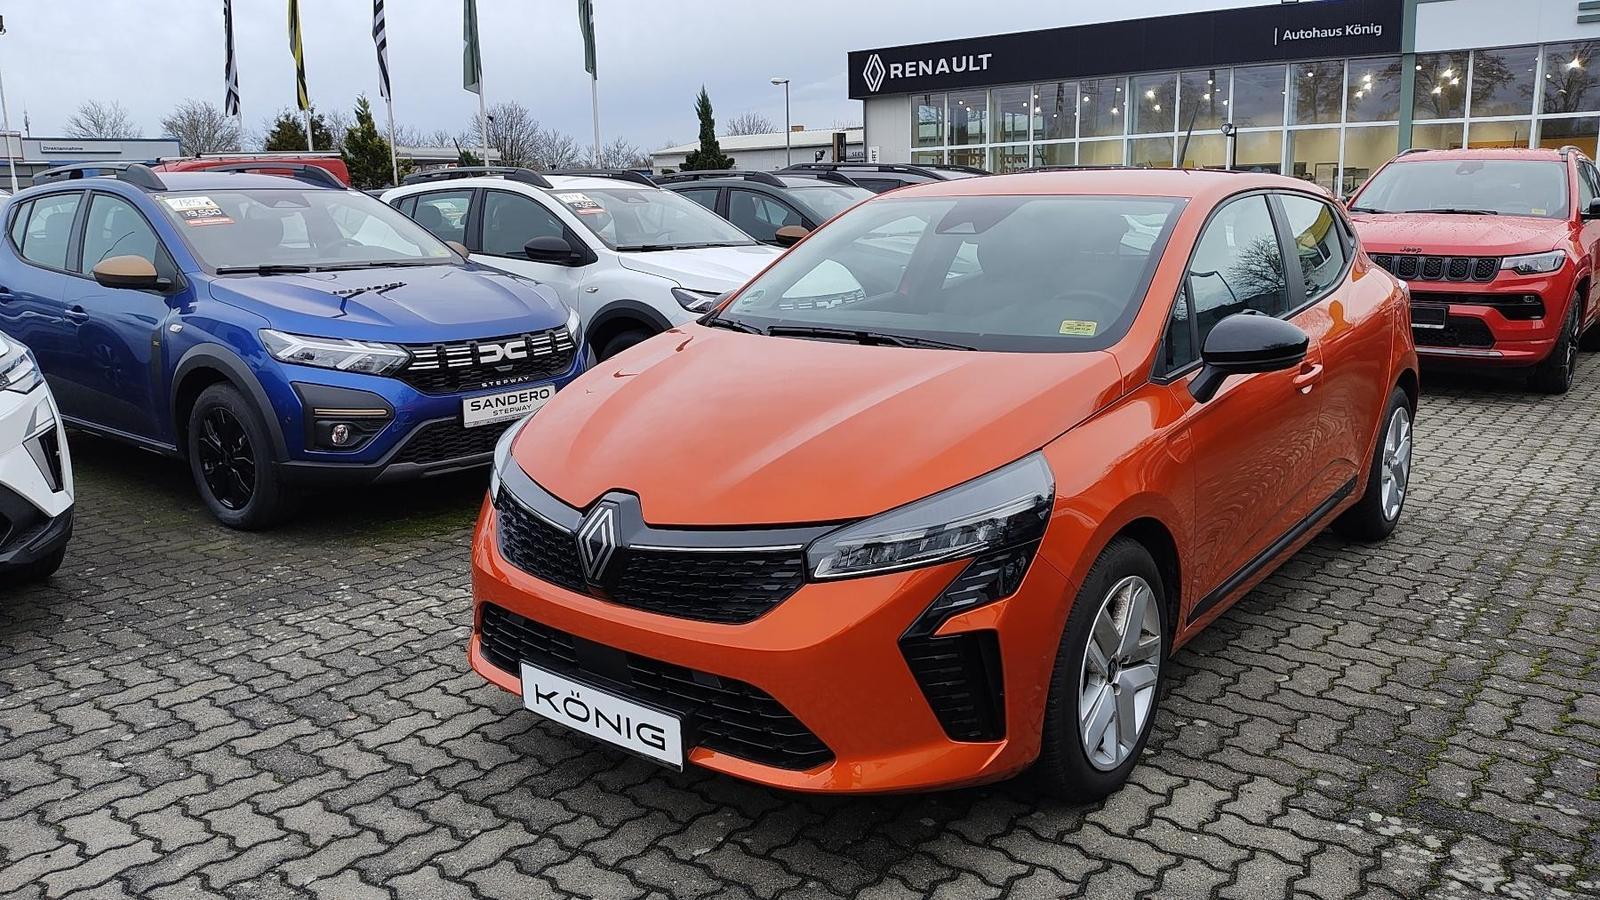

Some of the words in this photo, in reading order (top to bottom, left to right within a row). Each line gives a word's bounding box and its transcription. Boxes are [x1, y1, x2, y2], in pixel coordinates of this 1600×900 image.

[1283, 27, 1342, 41] Autohaus
[1345, 23, 1382, 36] König
[889, 53, 993, 79] RENAULT
[481, 376, 529, 387] STEPWAY
[470, 389, 550, 412] SANDERO
[493, 404, 532, 416] STEPWAY
[534, 683, 666, 751] KÖNIG
